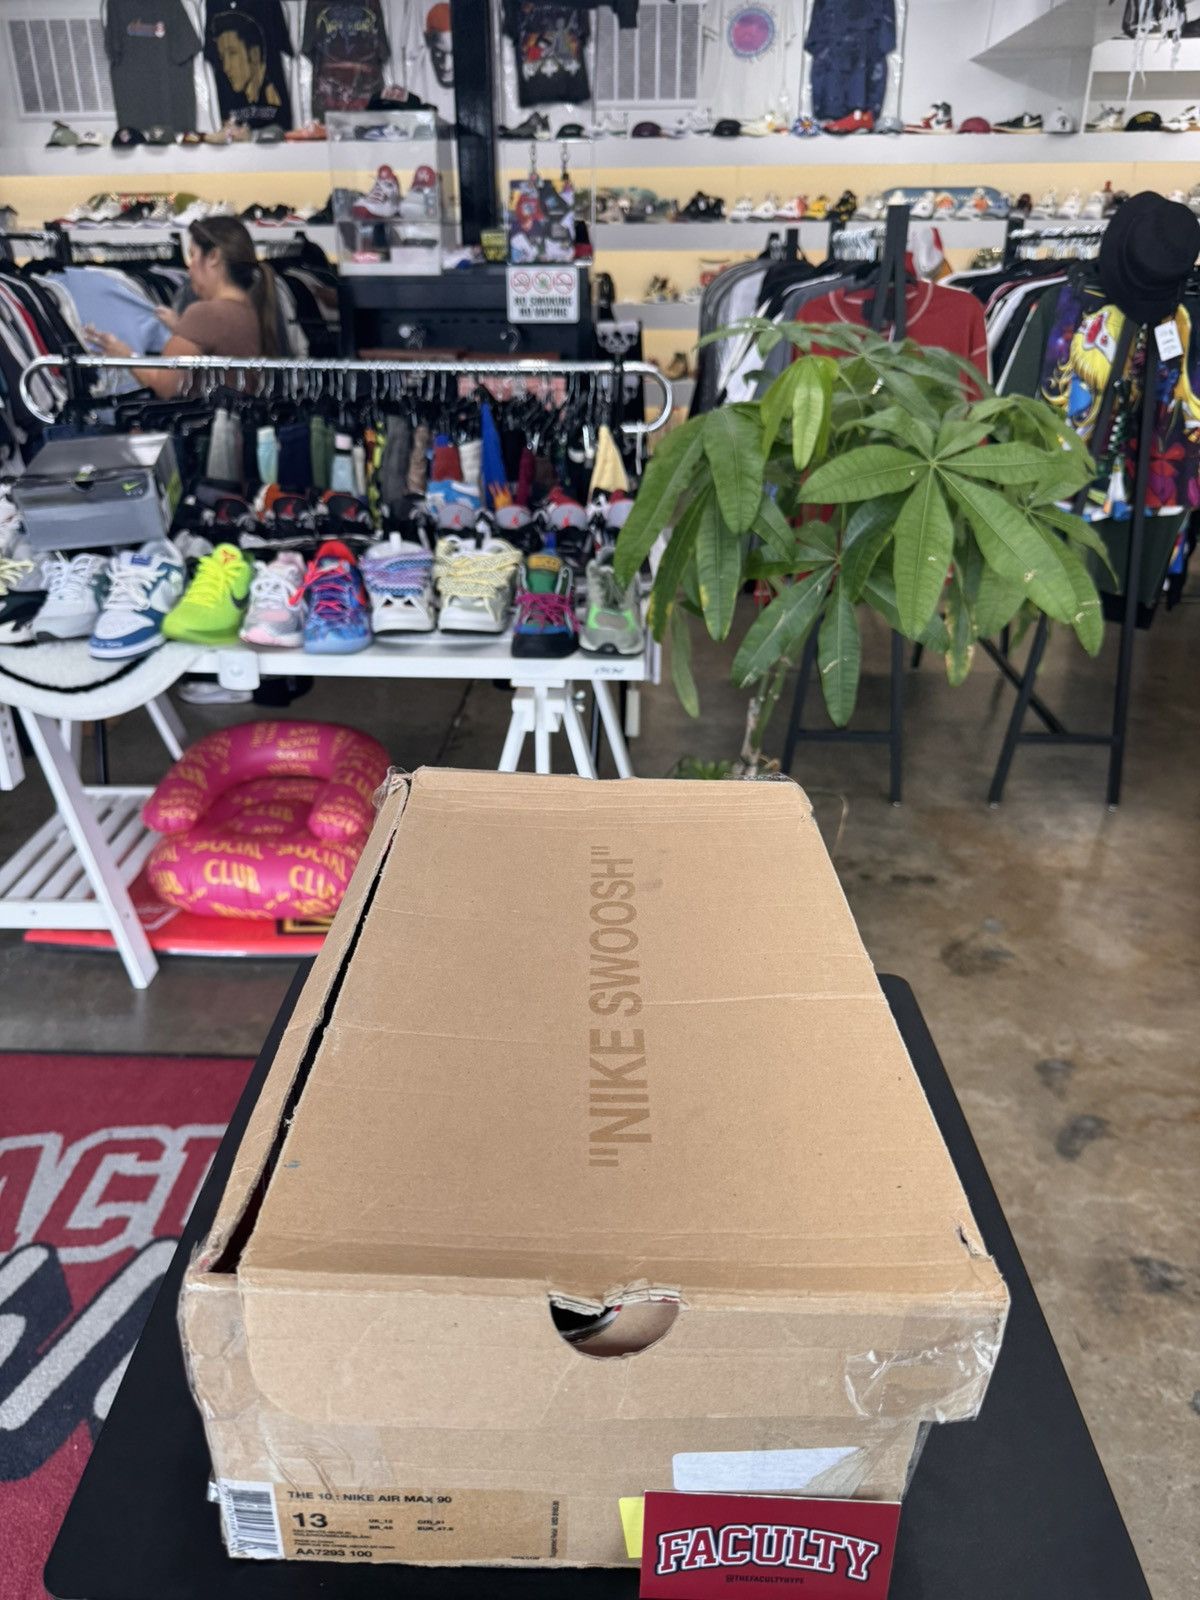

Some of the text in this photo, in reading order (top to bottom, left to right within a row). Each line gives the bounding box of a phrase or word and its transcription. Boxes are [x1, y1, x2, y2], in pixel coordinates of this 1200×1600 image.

[287, 1491, 315, 1500] THE
[343, 1494, 375, 1503] NIKE
[377, 1495, 400, 1503] AIR
[404, 1496, 434, 1504] MAX
[436, 1496, 453, 1504] 90
[292, 1512, 329, 1529] 13
[295, 1547, 373, 1558] AA7293 100
[656, 1525, 881, 1581] FACULTY
